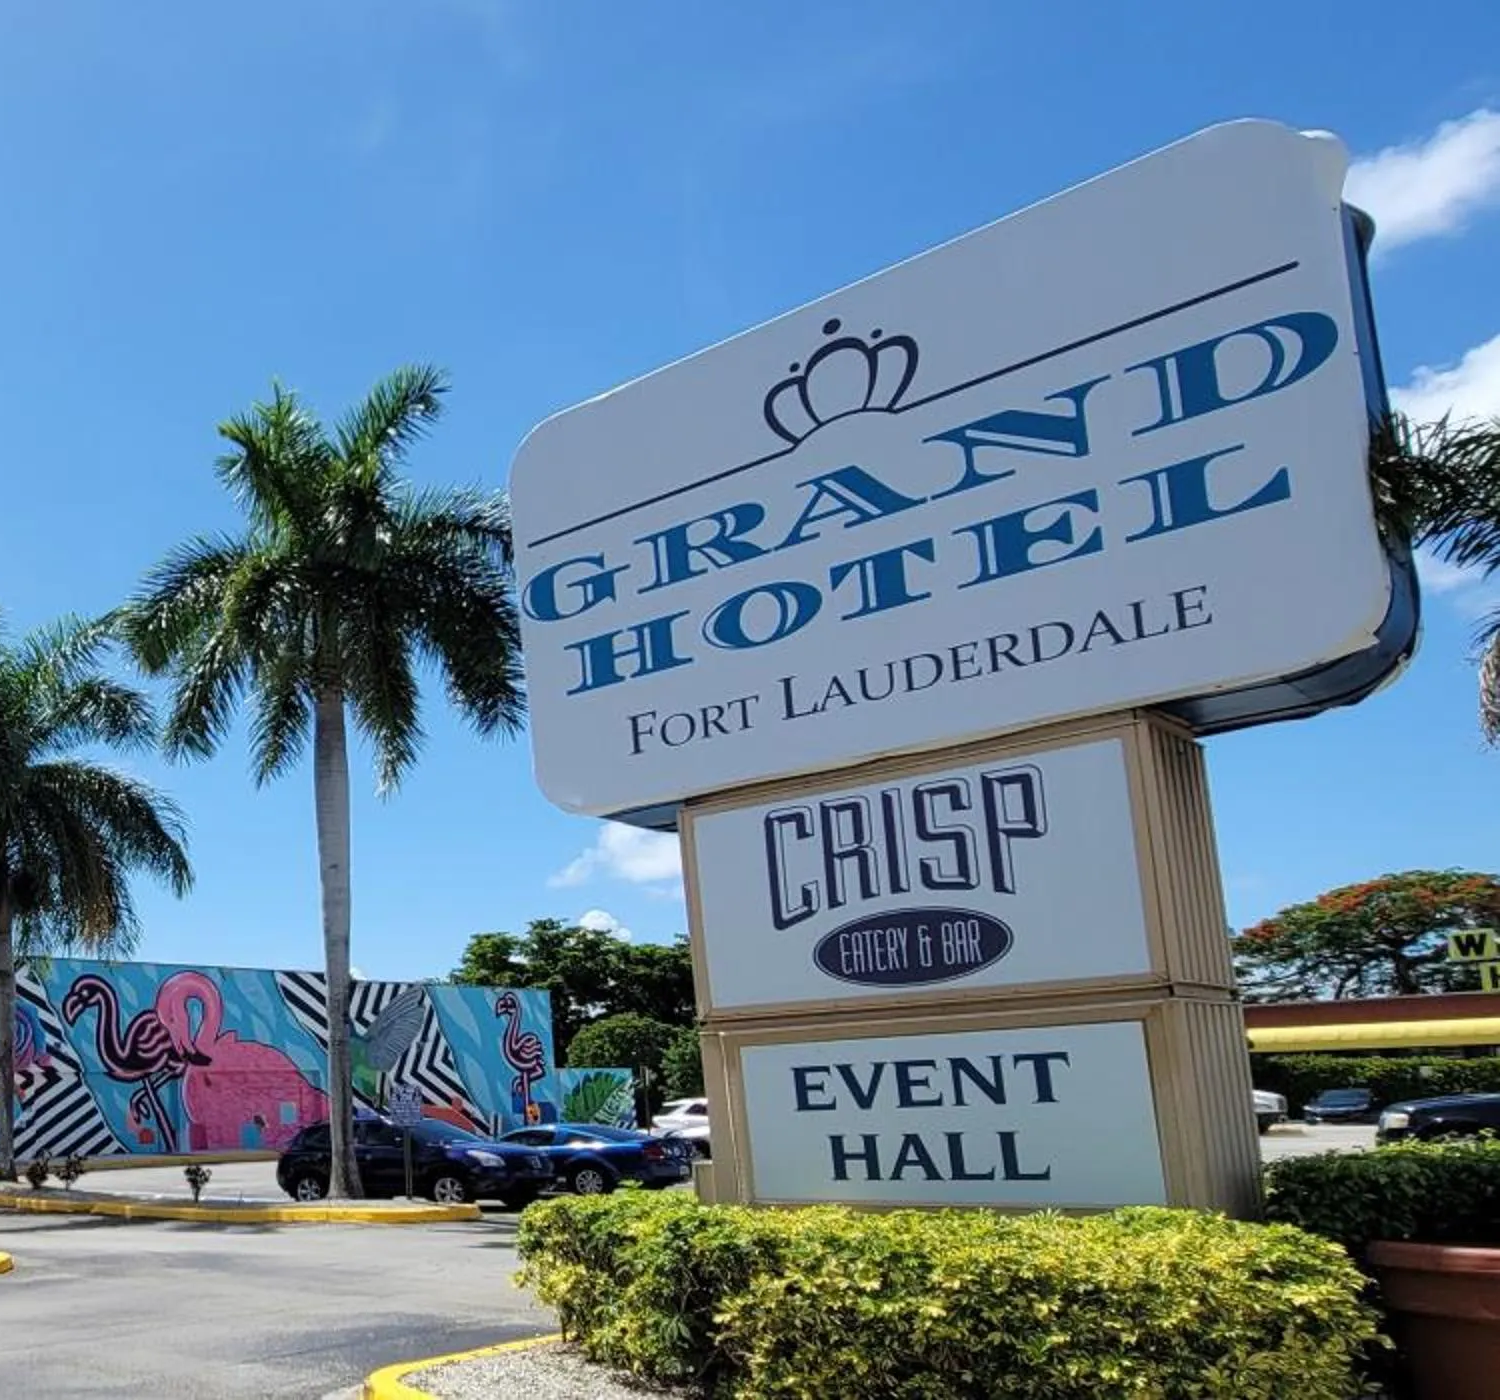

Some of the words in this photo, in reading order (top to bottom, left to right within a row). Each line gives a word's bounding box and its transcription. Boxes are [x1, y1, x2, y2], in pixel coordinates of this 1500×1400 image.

[521, 312, 1339, 622] GRAND
[564, 444, 1291, 696] HOTEL
[626, 696, 761, 755] FORT
[779, 586, 1214, 720] LAUDERDALE
[764, 764, 1048, 931] CRISP
[840, 927, 909, 976] EATERY
[918, 924, 933, 968] &
[941, 920, 984, 966] BAR
[791, 1052, 1071, 1112] EVENT
[828, 1131, 1052, 1181] HALL
